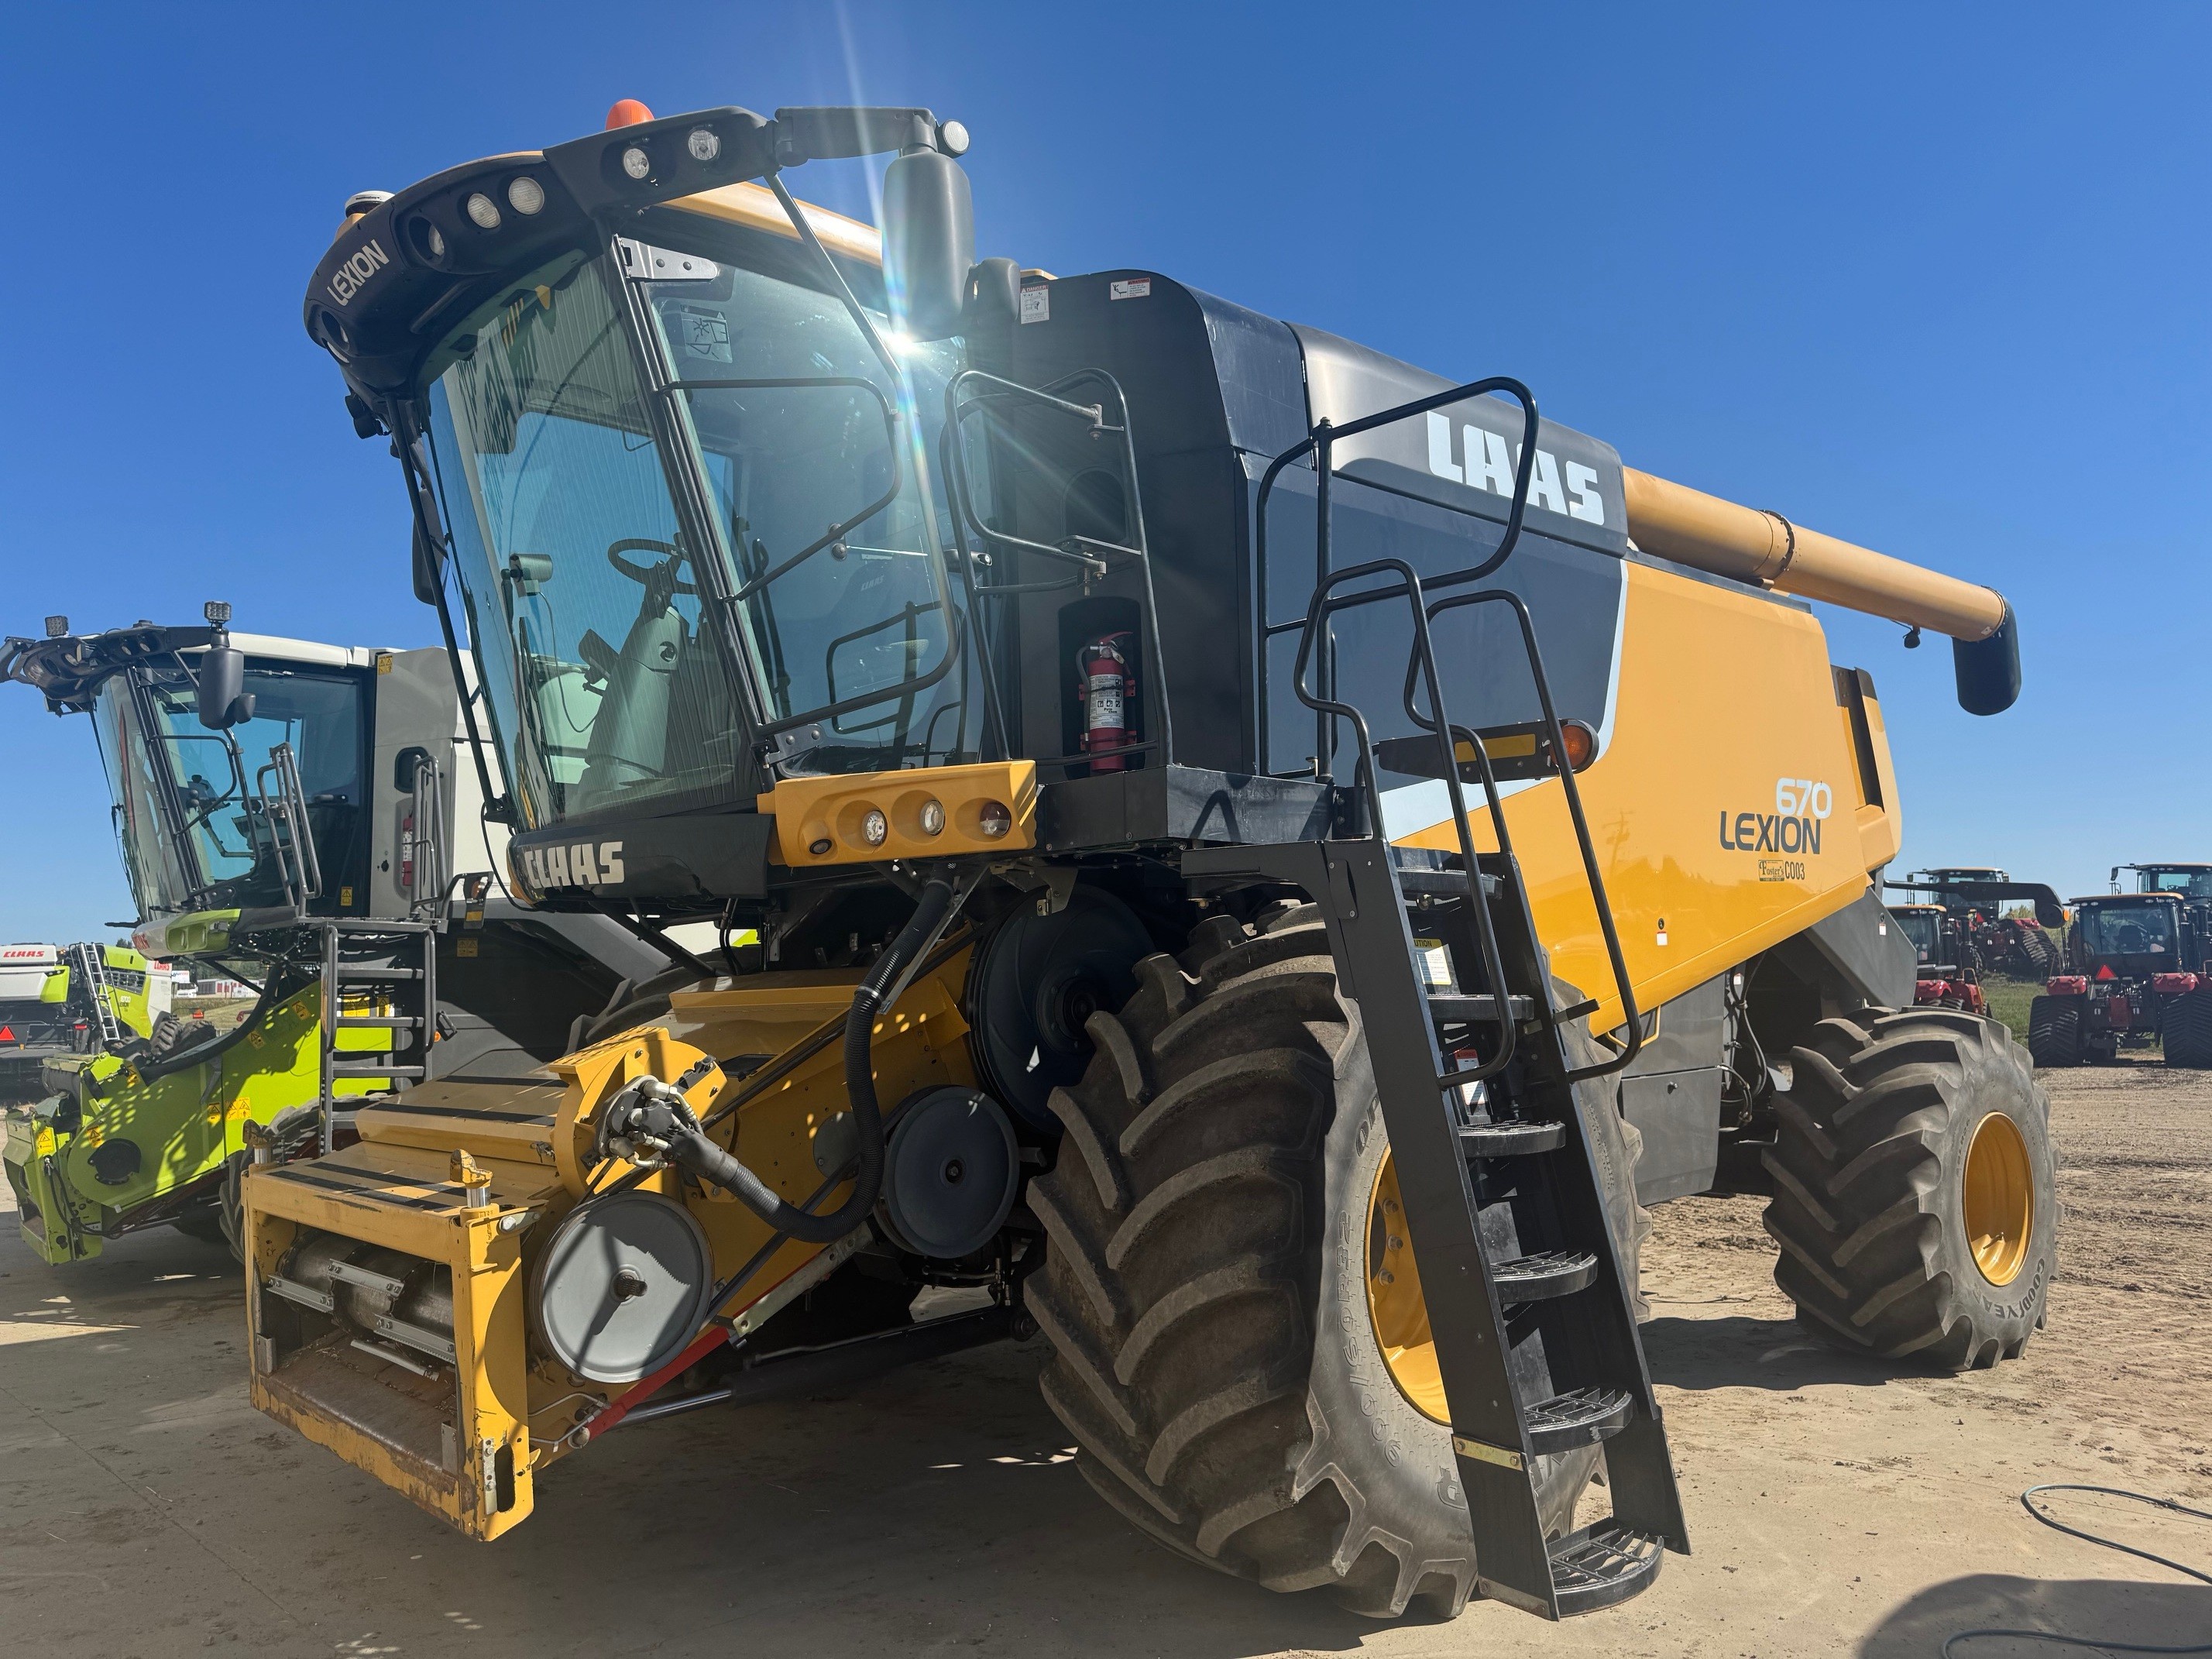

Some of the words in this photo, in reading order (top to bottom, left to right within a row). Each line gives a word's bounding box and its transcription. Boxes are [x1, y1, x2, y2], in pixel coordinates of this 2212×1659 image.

[327, 239, 390, 307] LEXION
[1777, 778, 1832, 819] 670
[1720, 811, 1820, 854] LEXION
[524, 841, 625, 889] CLAAS
[1759, 860, 1784, 875] Foster's
[1973, 1257, 2045, 1320] GOODYEAR
